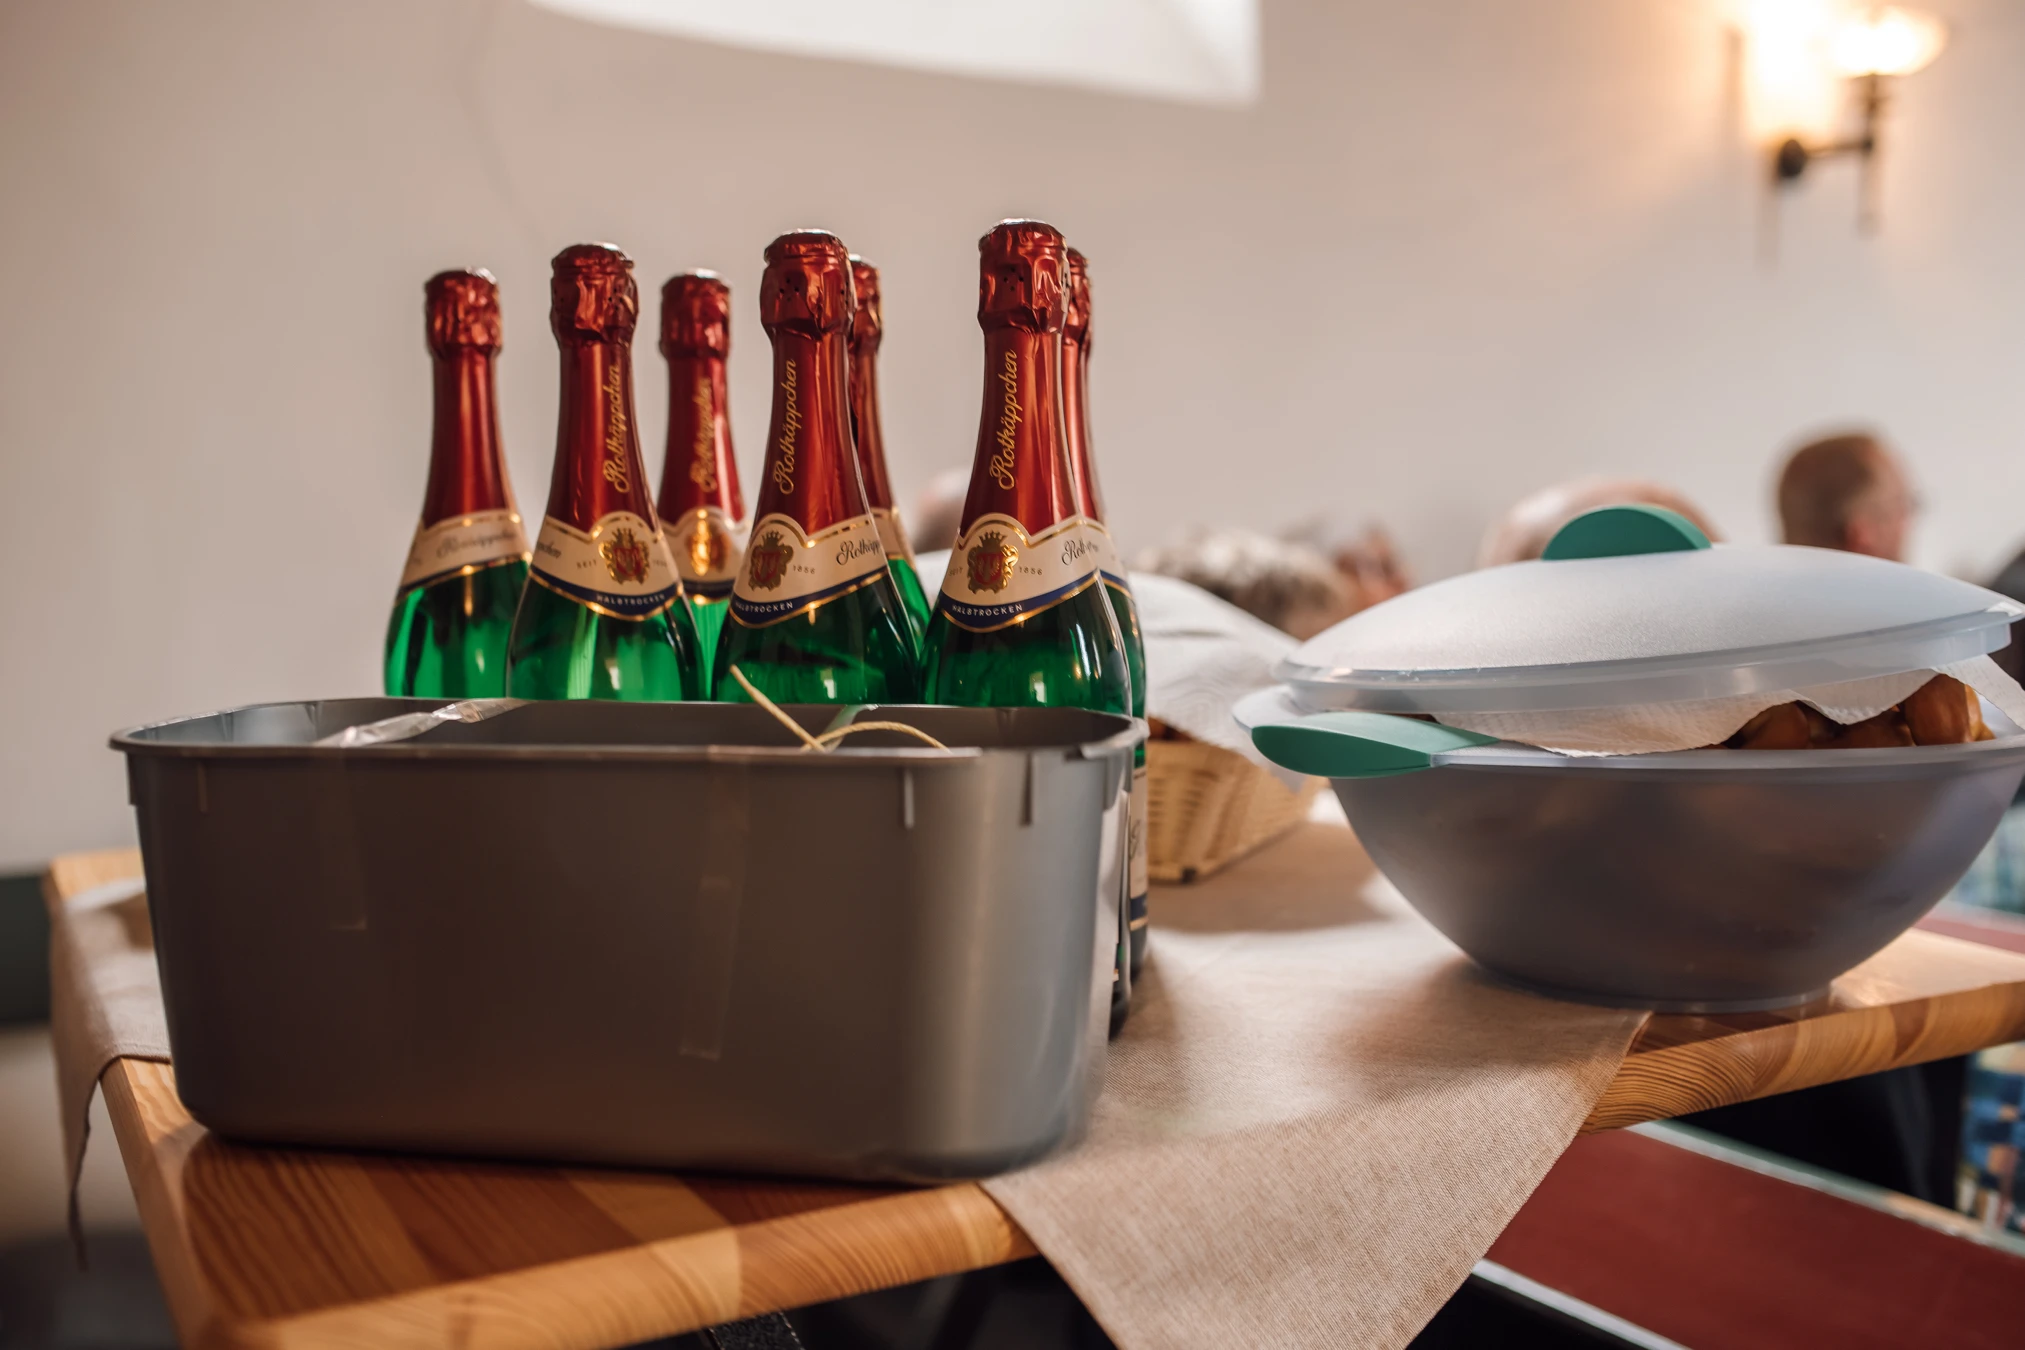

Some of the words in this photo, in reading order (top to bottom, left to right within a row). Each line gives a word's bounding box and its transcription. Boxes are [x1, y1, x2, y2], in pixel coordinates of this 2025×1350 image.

[602, 363, 630, 494] Rotkäppchen
[772, 358, 803, 495] Rotkäppchen
[988, 348, 1024, 491] Rotkäppchen
